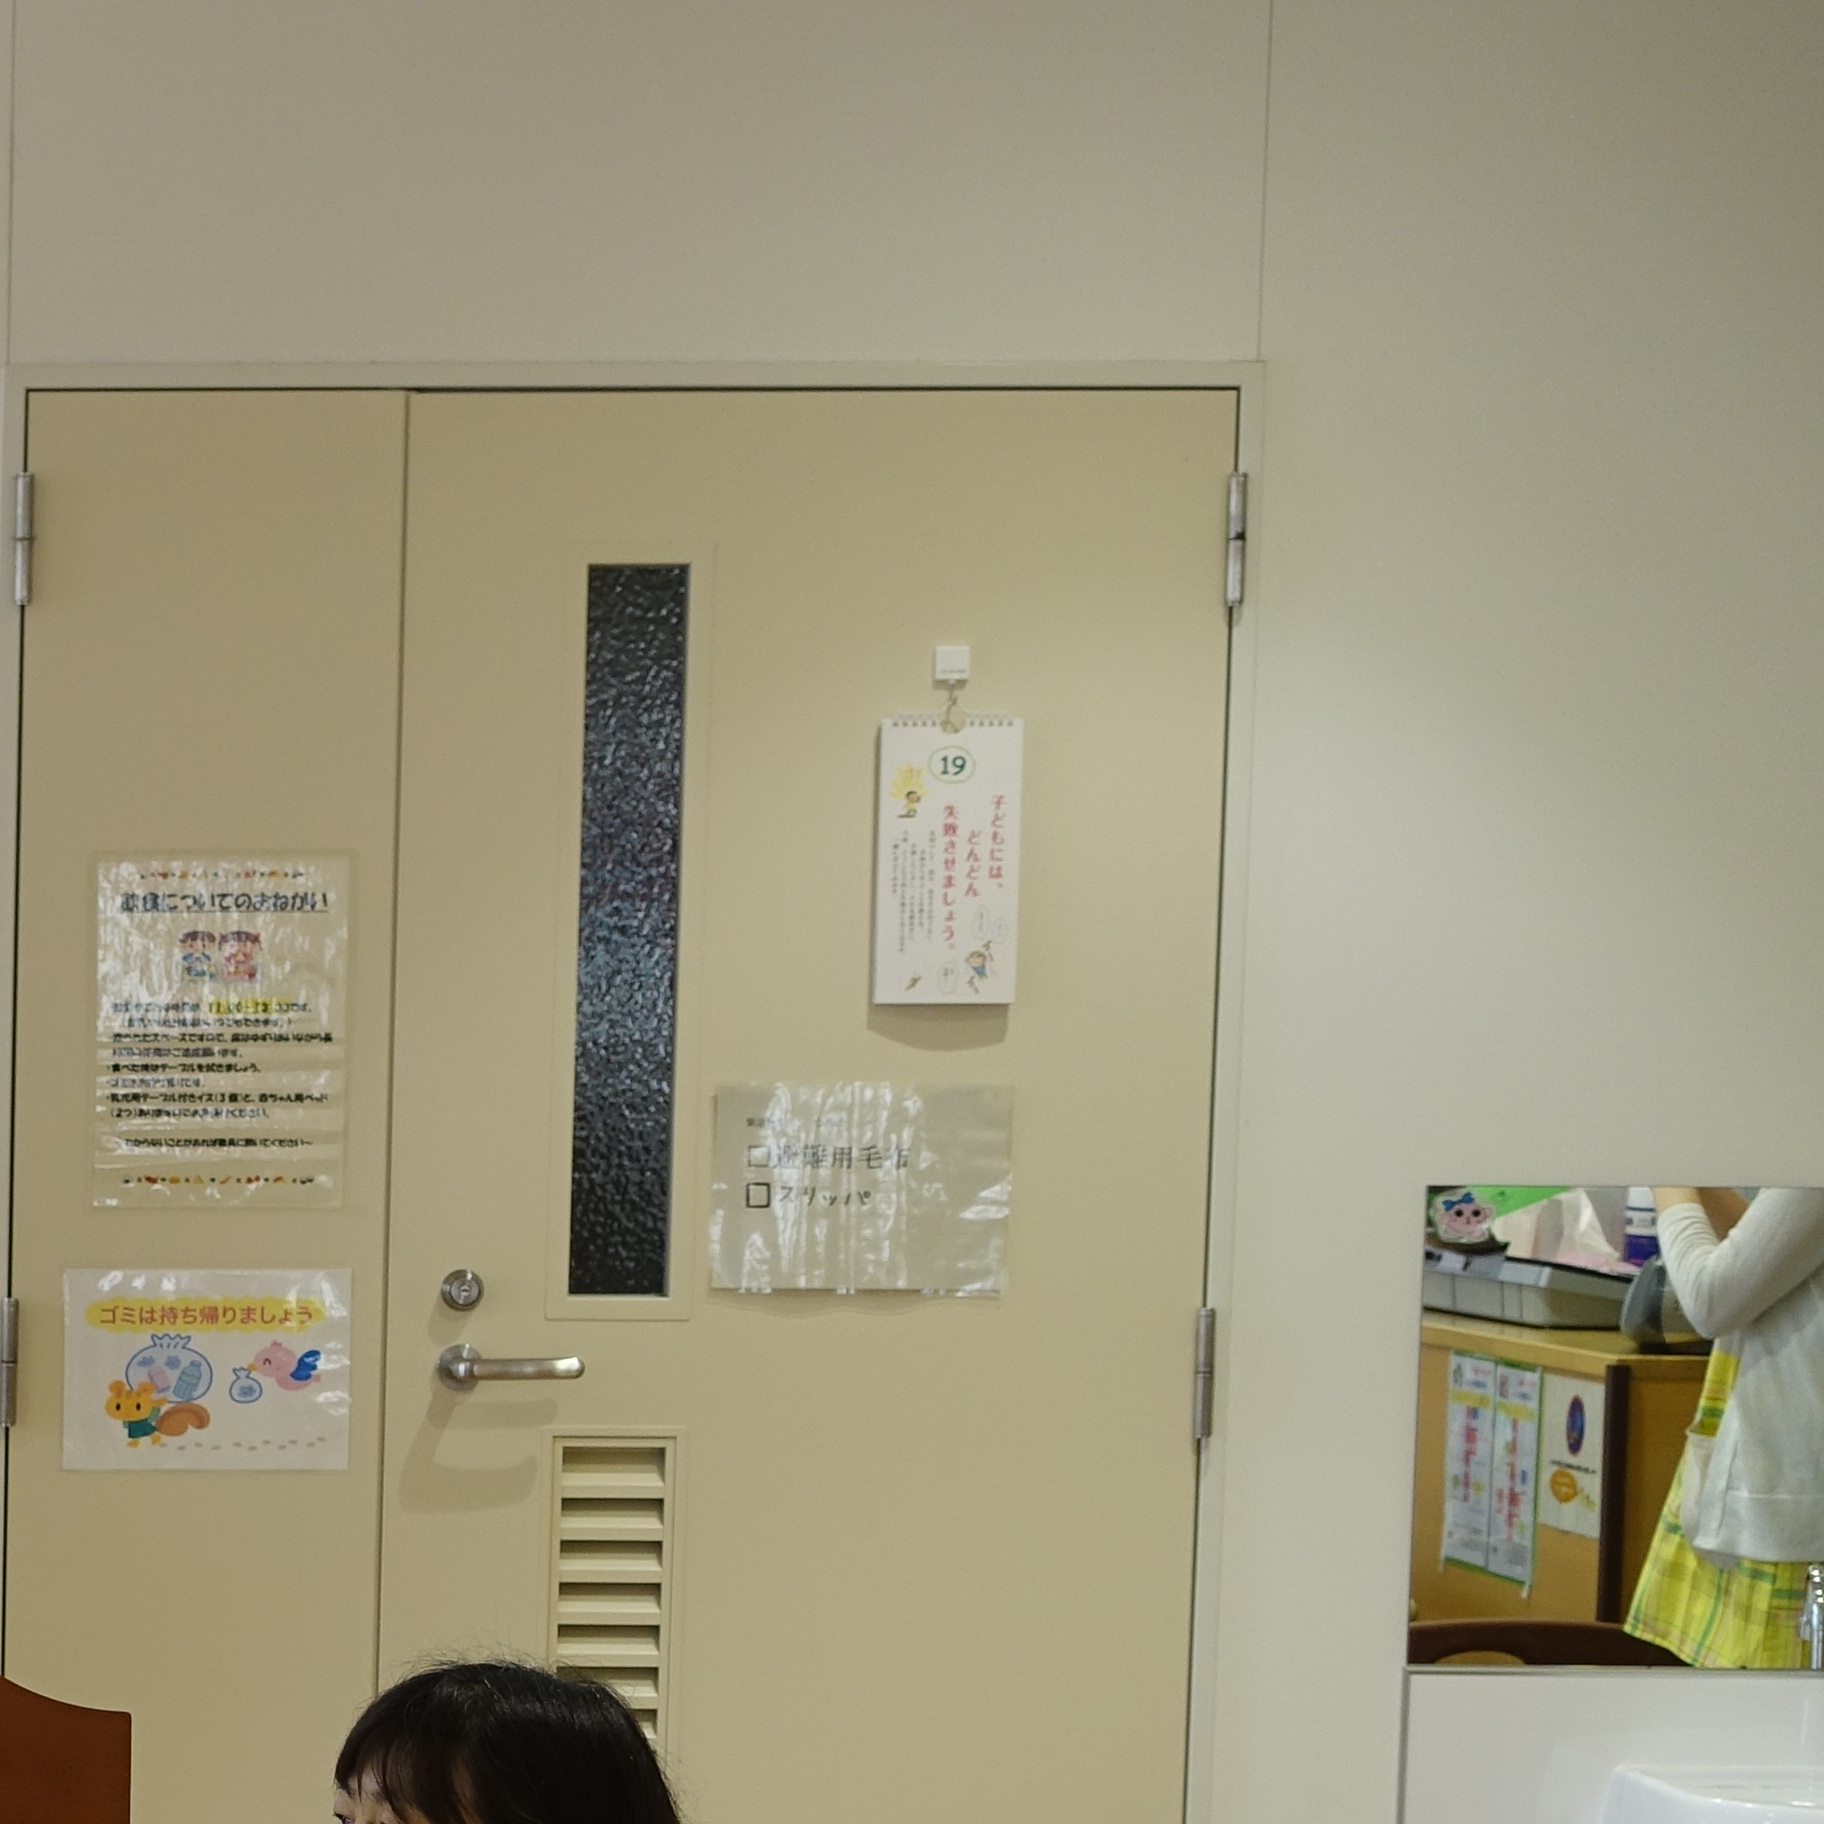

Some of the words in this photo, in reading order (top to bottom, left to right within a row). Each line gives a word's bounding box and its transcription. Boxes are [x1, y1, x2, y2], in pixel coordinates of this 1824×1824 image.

[940, 755, 967, 776] 19
[965, 829, 982, 897] どんどん
[780, 1185, 872, 1206] スリッパ
[99, 1305, 314, 1326] ゴミは持ち帰りましょう
